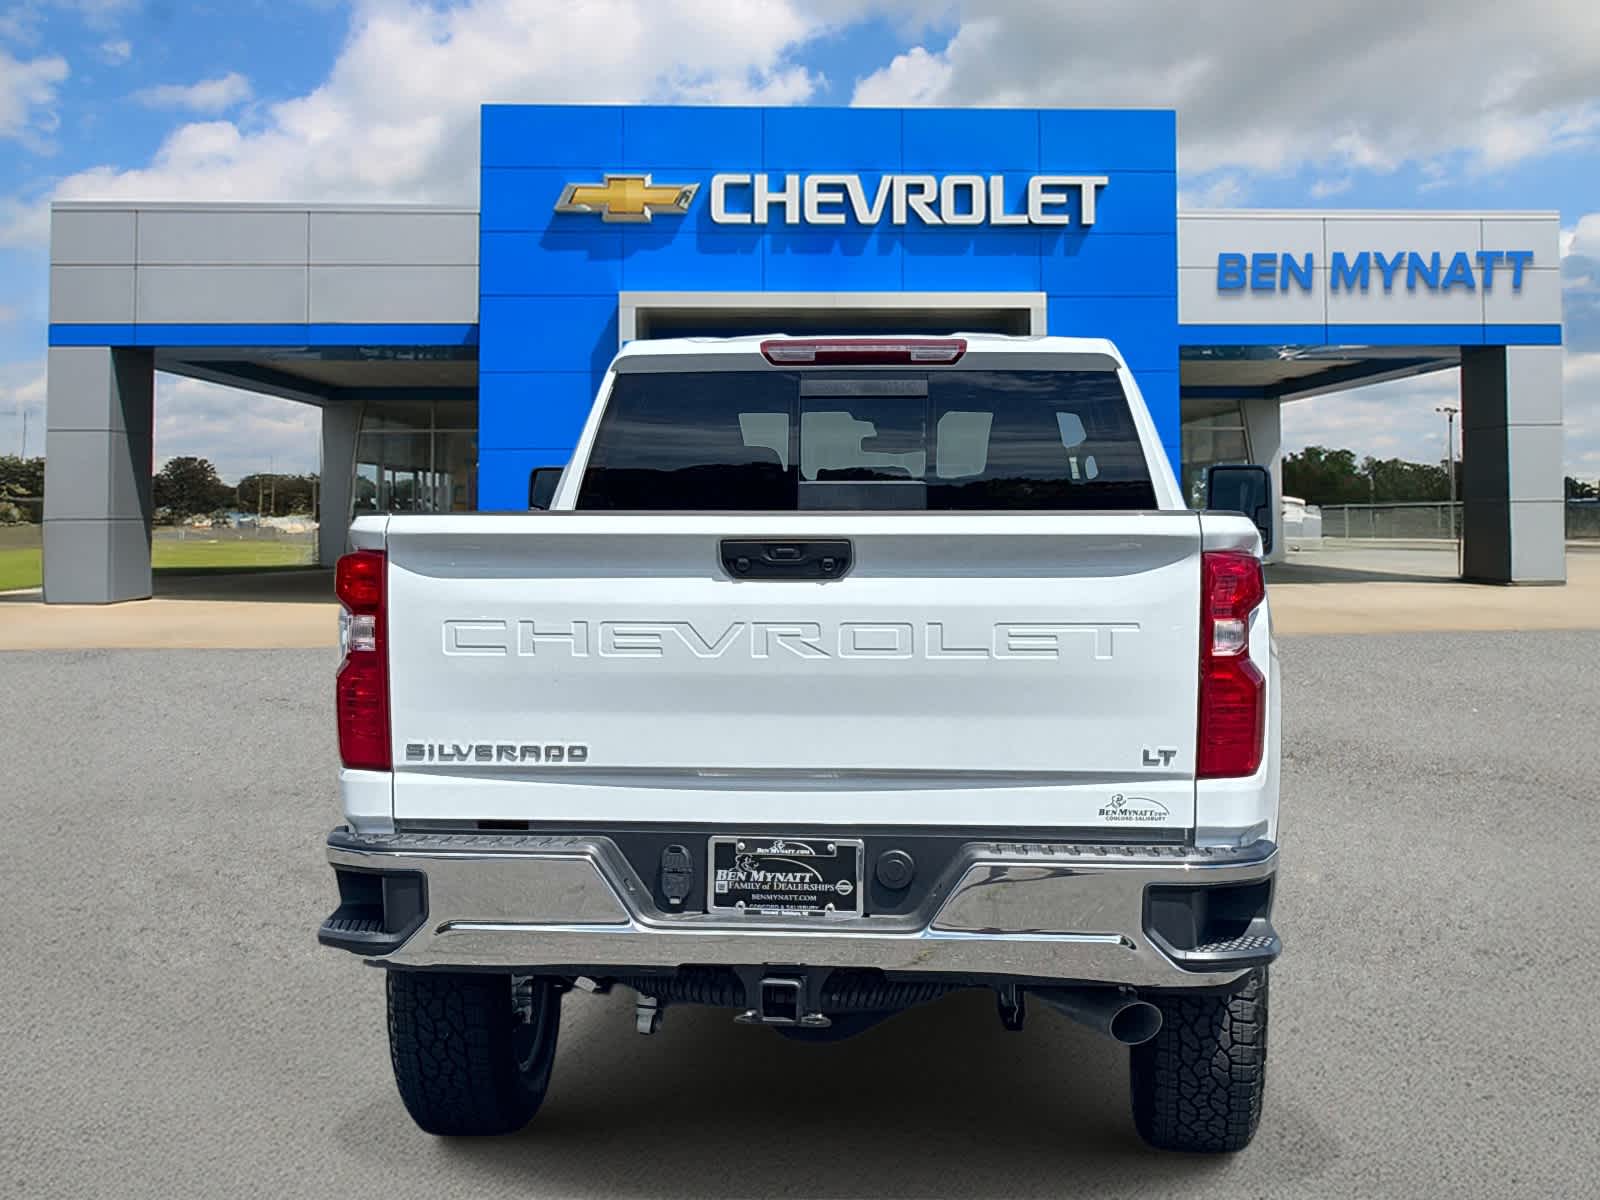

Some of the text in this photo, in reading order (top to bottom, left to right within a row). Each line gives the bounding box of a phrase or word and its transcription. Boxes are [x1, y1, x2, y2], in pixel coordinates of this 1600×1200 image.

[710, 173, 1110, 226] CHEVROLET
[1217, 250, 1534, 291] BEN MYNATT
[441, 619, 1141, 660] CHEVROLET
[405, 743, 589, 762] SILVERADO
[1142, 748, 1177, 767] LT
[715, 869, 814, 882] BEN MYNATT
[728, 880, 762, 891] FAMILY
[773, 881, 835, 892] DEALERSHIPS
